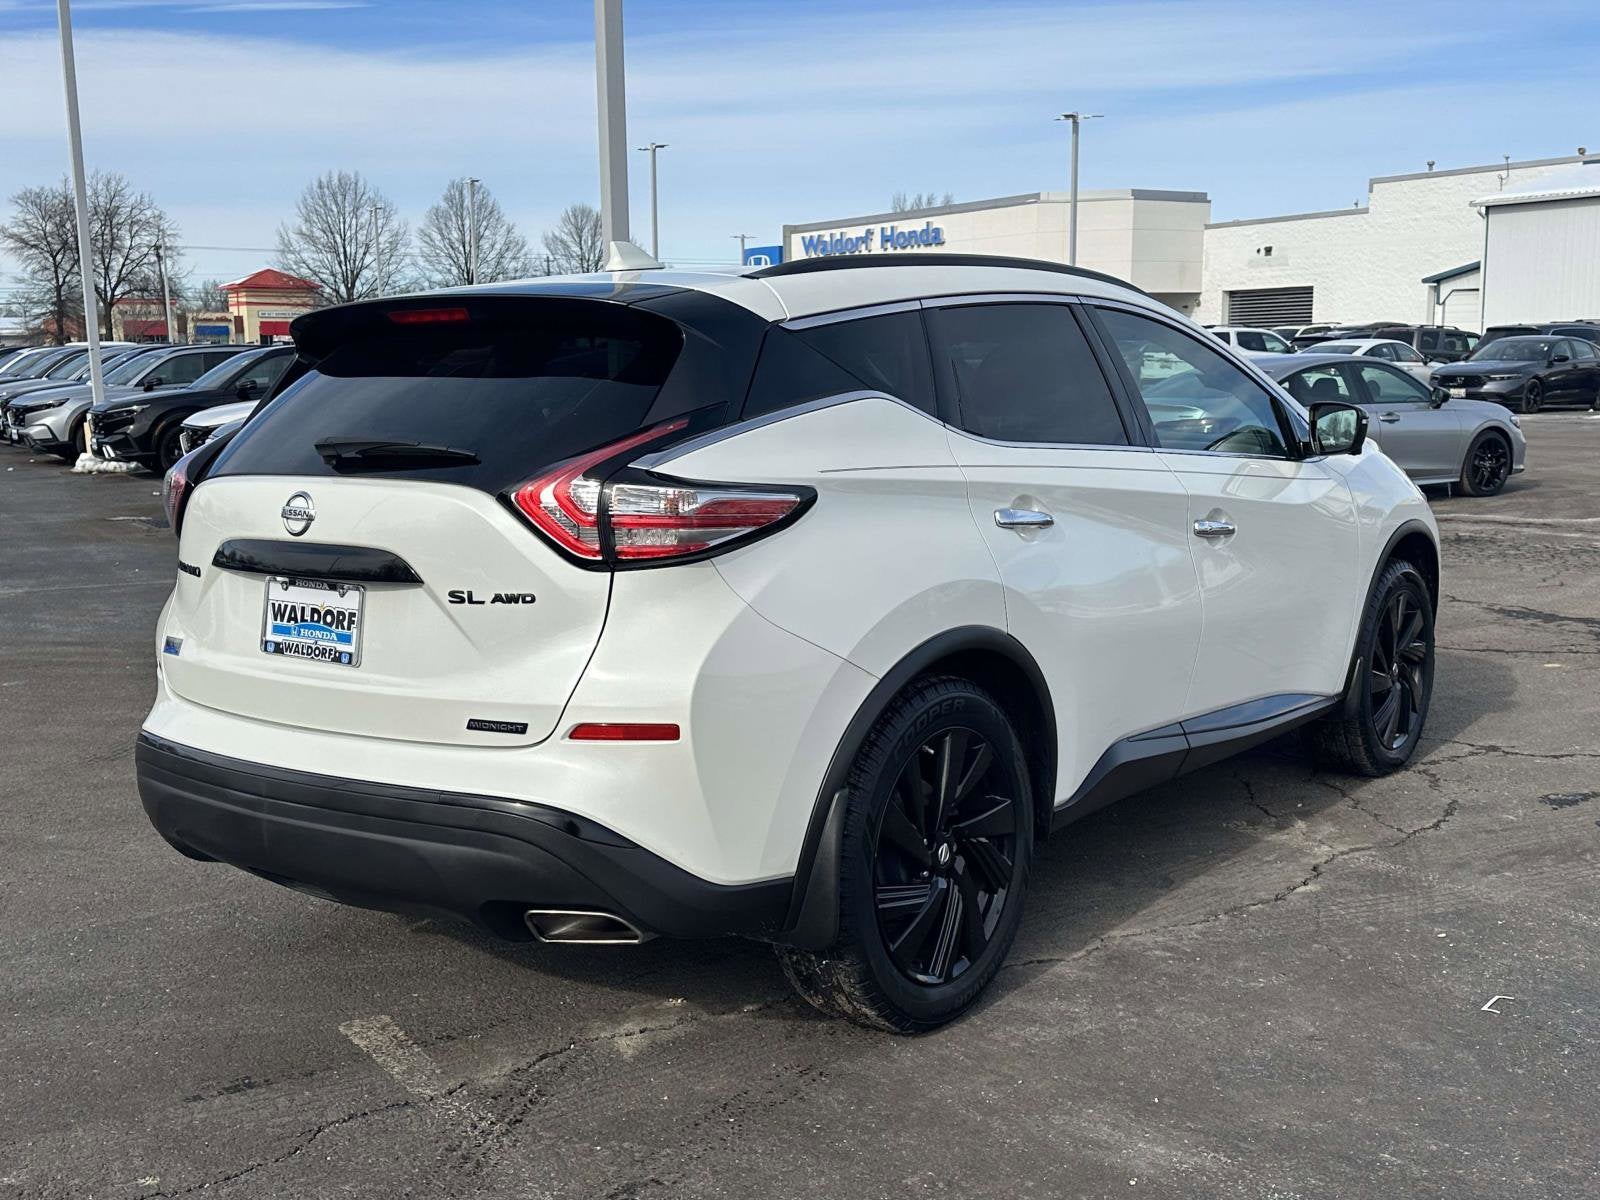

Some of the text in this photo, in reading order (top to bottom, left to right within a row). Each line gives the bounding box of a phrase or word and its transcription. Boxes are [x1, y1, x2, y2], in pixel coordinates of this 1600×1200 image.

[801, 221, 946, 257] Waldorf Honda
[295, 580, 329, 590] HONDA
[448, 590, 536, 605] SL AWD
[271, 602, 357, 631] WALDORF
[300, 629, 337, 641] HONDA
[283, 642, 335, 660] WALDORF
[469, 721, 524, 732] MIDNIGHT
